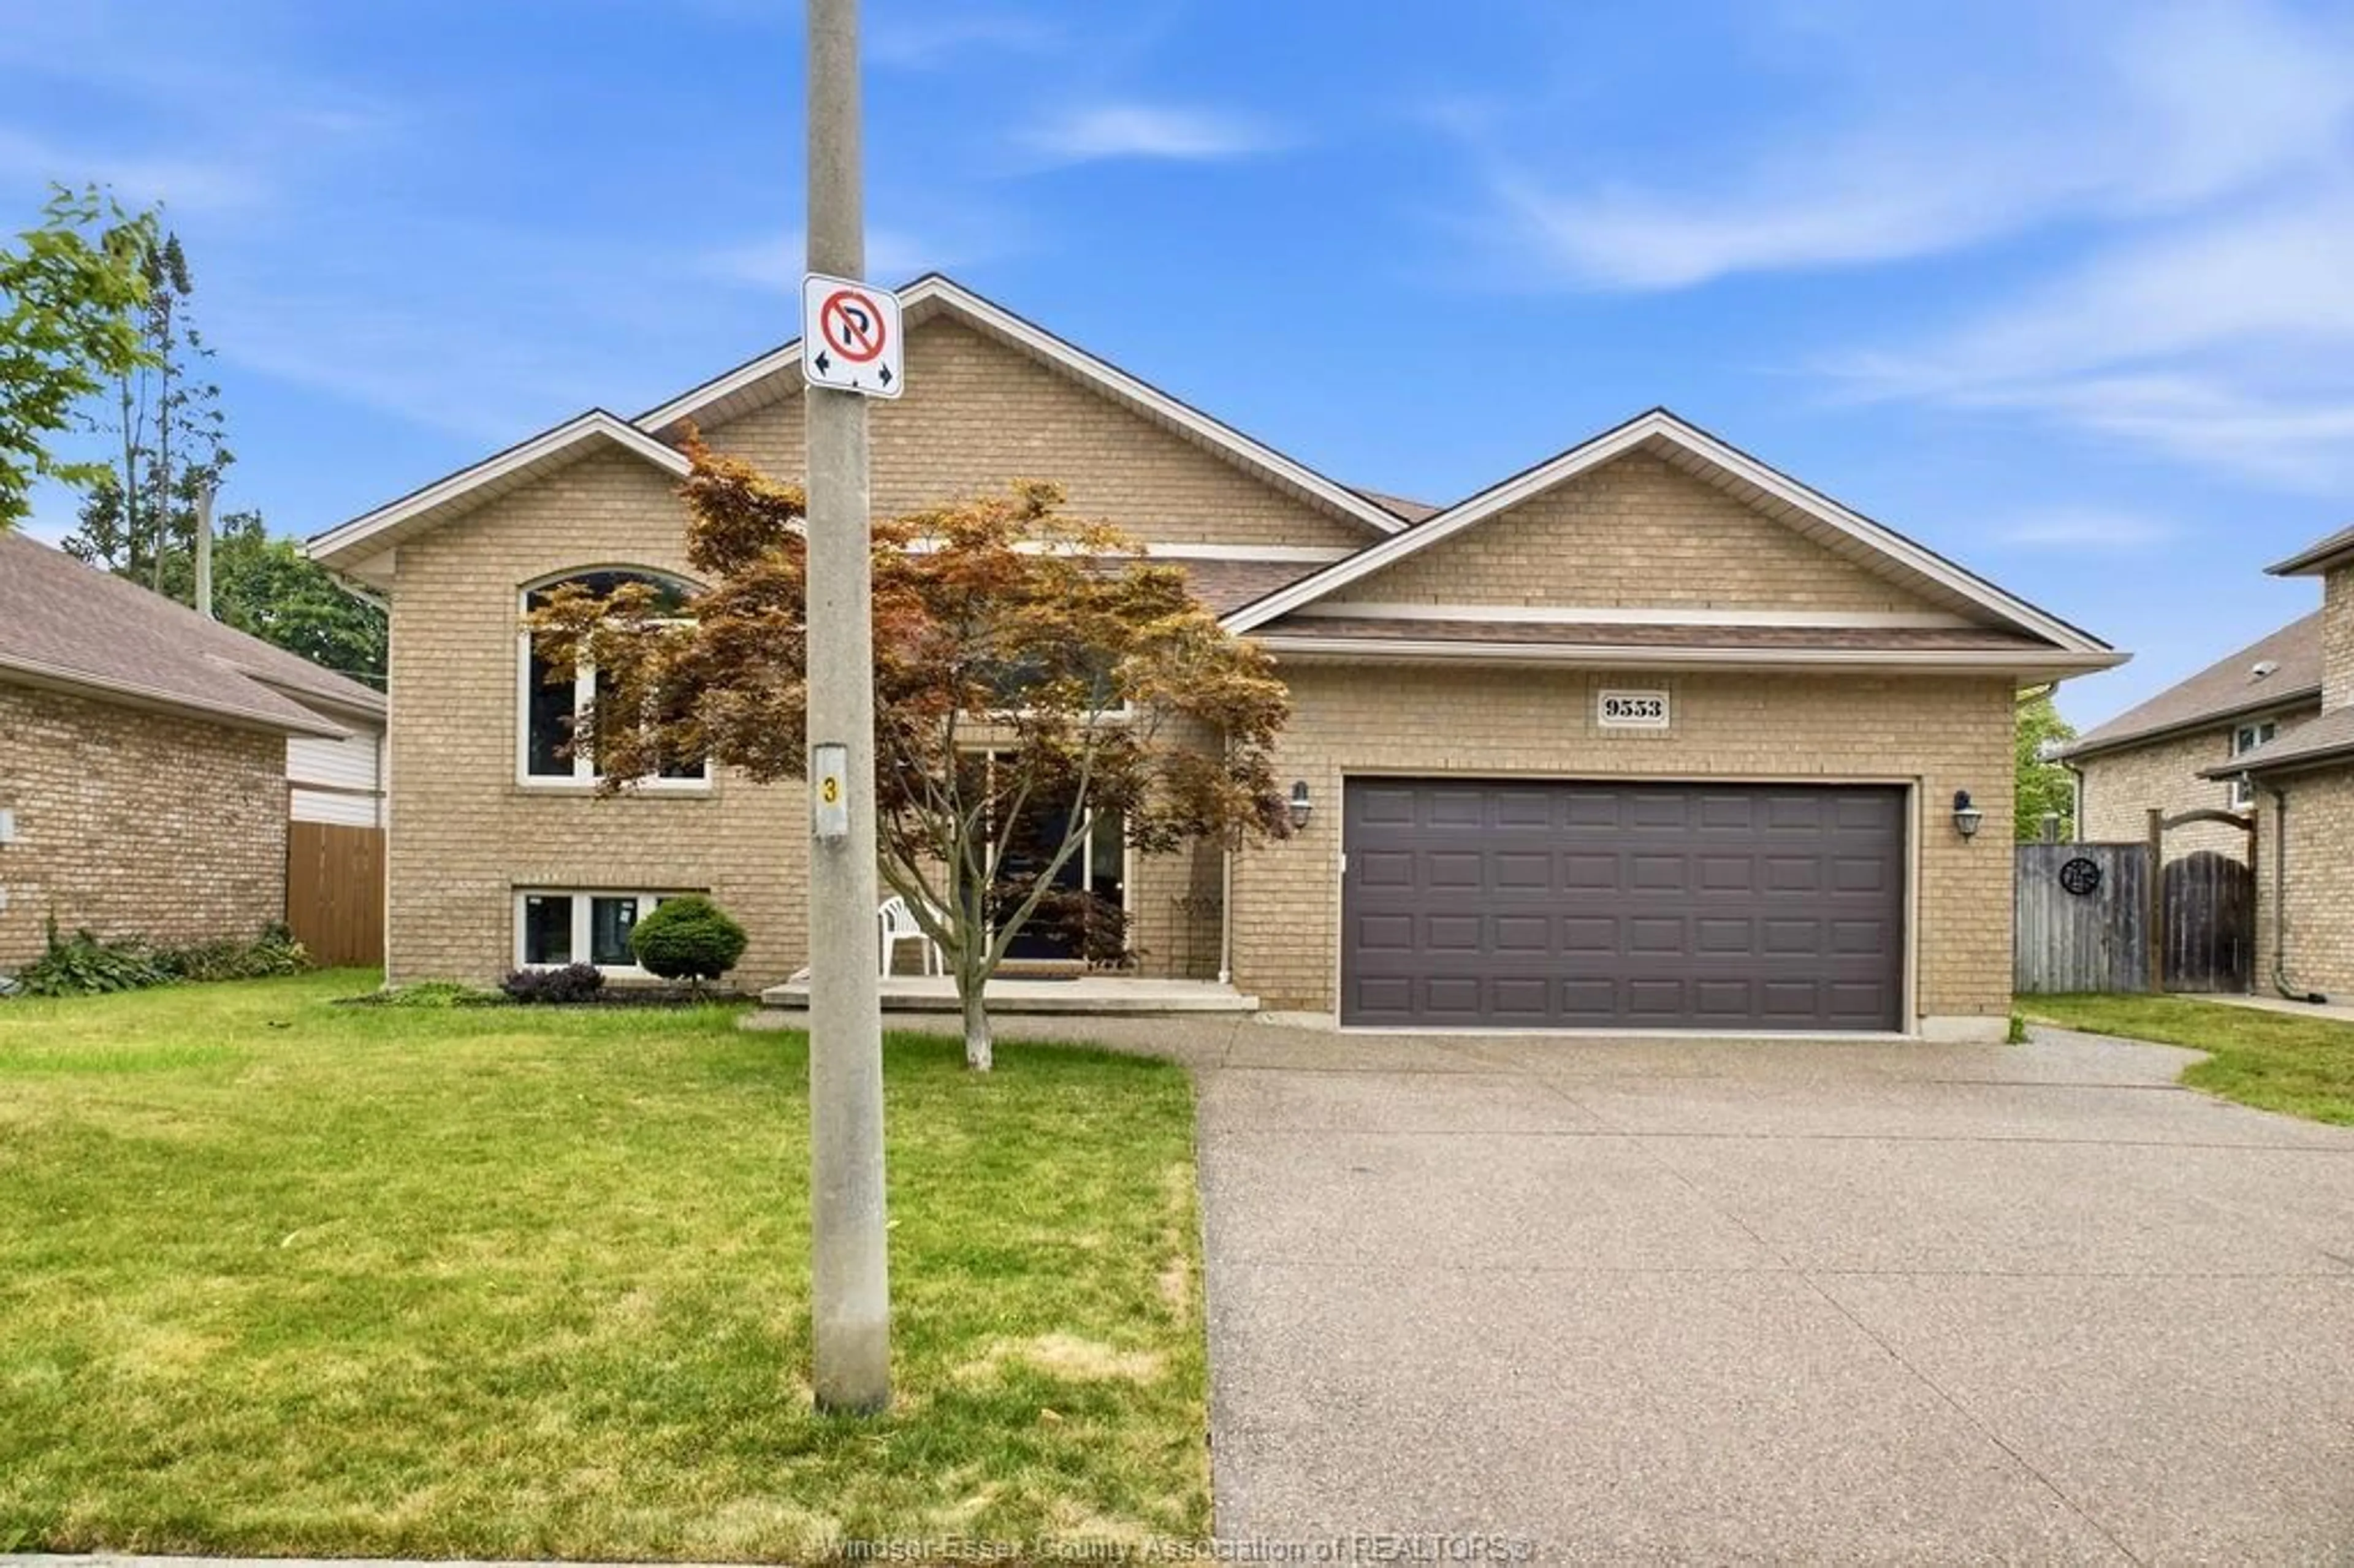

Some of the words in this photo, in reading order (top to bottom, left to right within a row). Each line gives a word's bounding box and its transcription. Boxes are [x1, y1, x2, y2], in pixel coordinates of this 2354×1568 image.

[843, 306, 869, 345] P
[1606, 699, 1661, 717] 9553
[825, 776, 836, 803] 3
